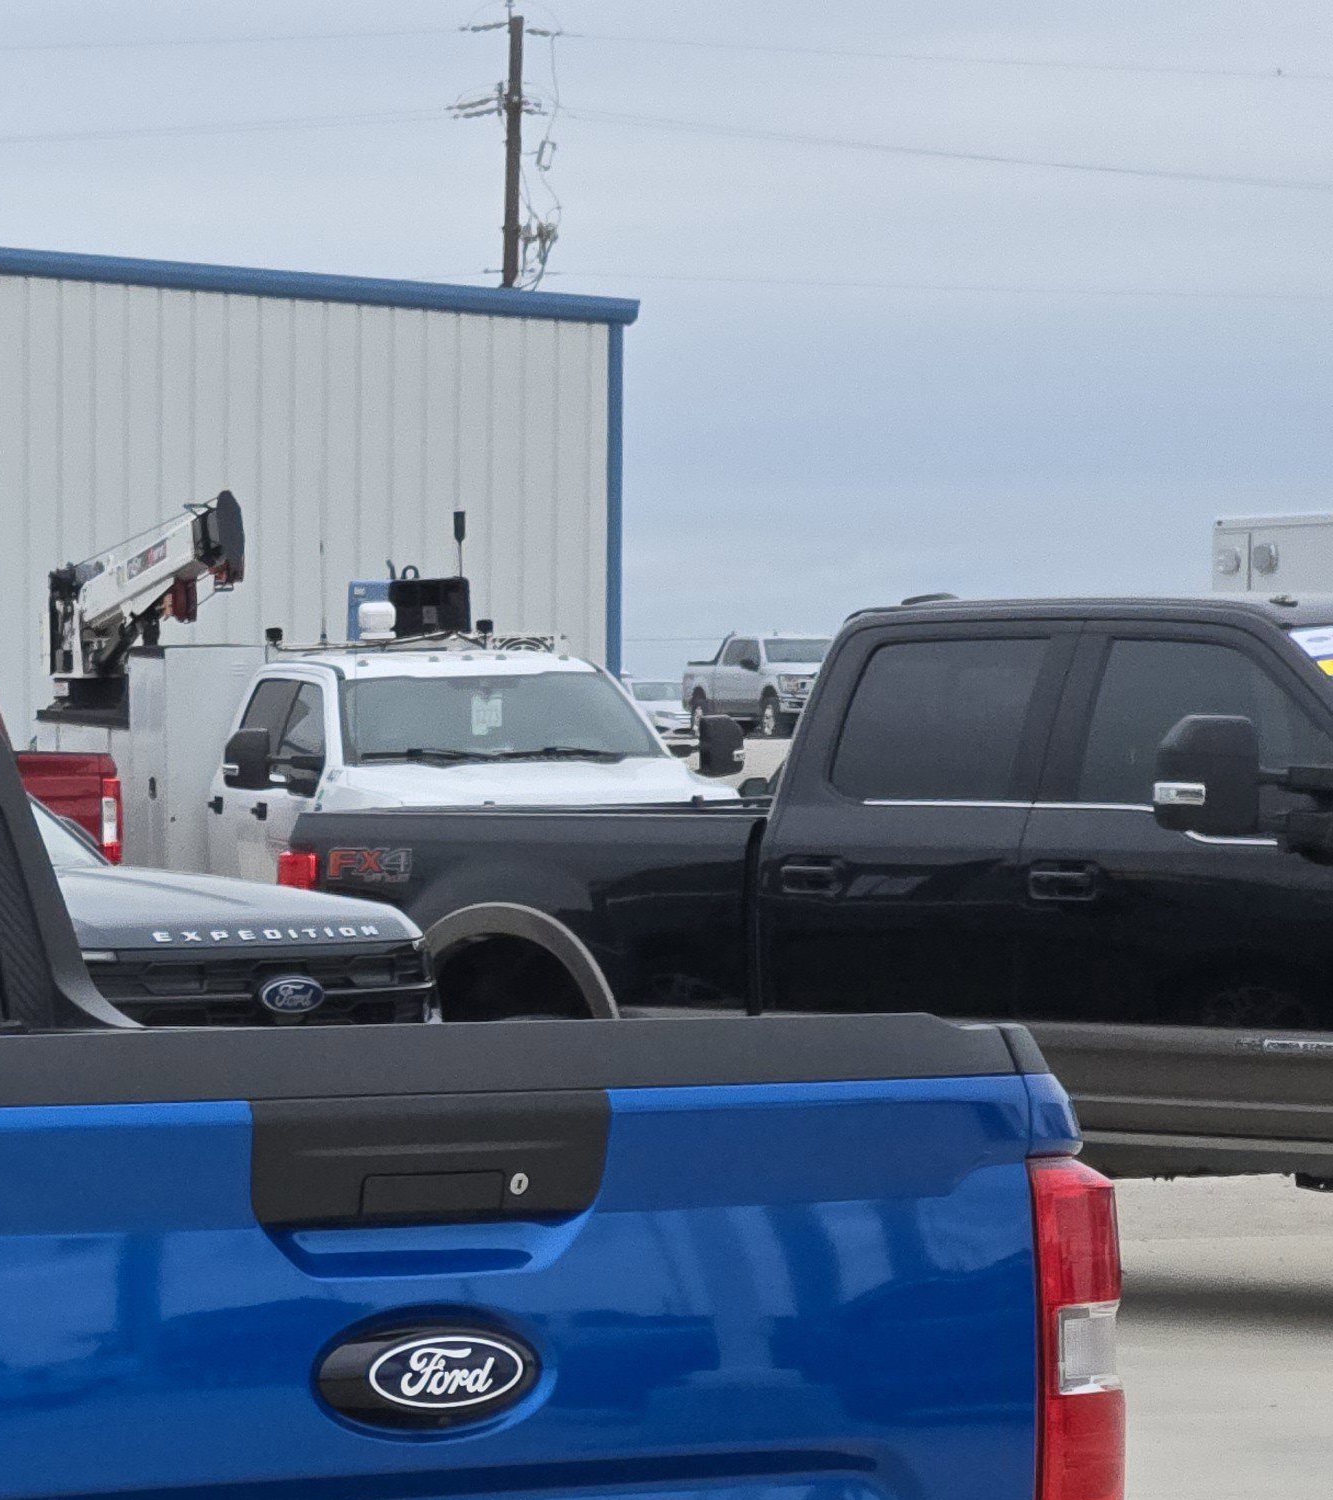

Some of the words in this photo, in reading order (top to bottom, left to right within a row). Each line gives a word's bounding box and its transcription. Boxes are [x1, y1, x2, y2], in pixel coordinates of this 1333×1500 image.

[327, 847, 412, 880] FX4
[152, 925, 380, 943] EXPEDITION
[274, 984, 314, 1008] Ford
[400, 1347, 495, 1397] Ford
